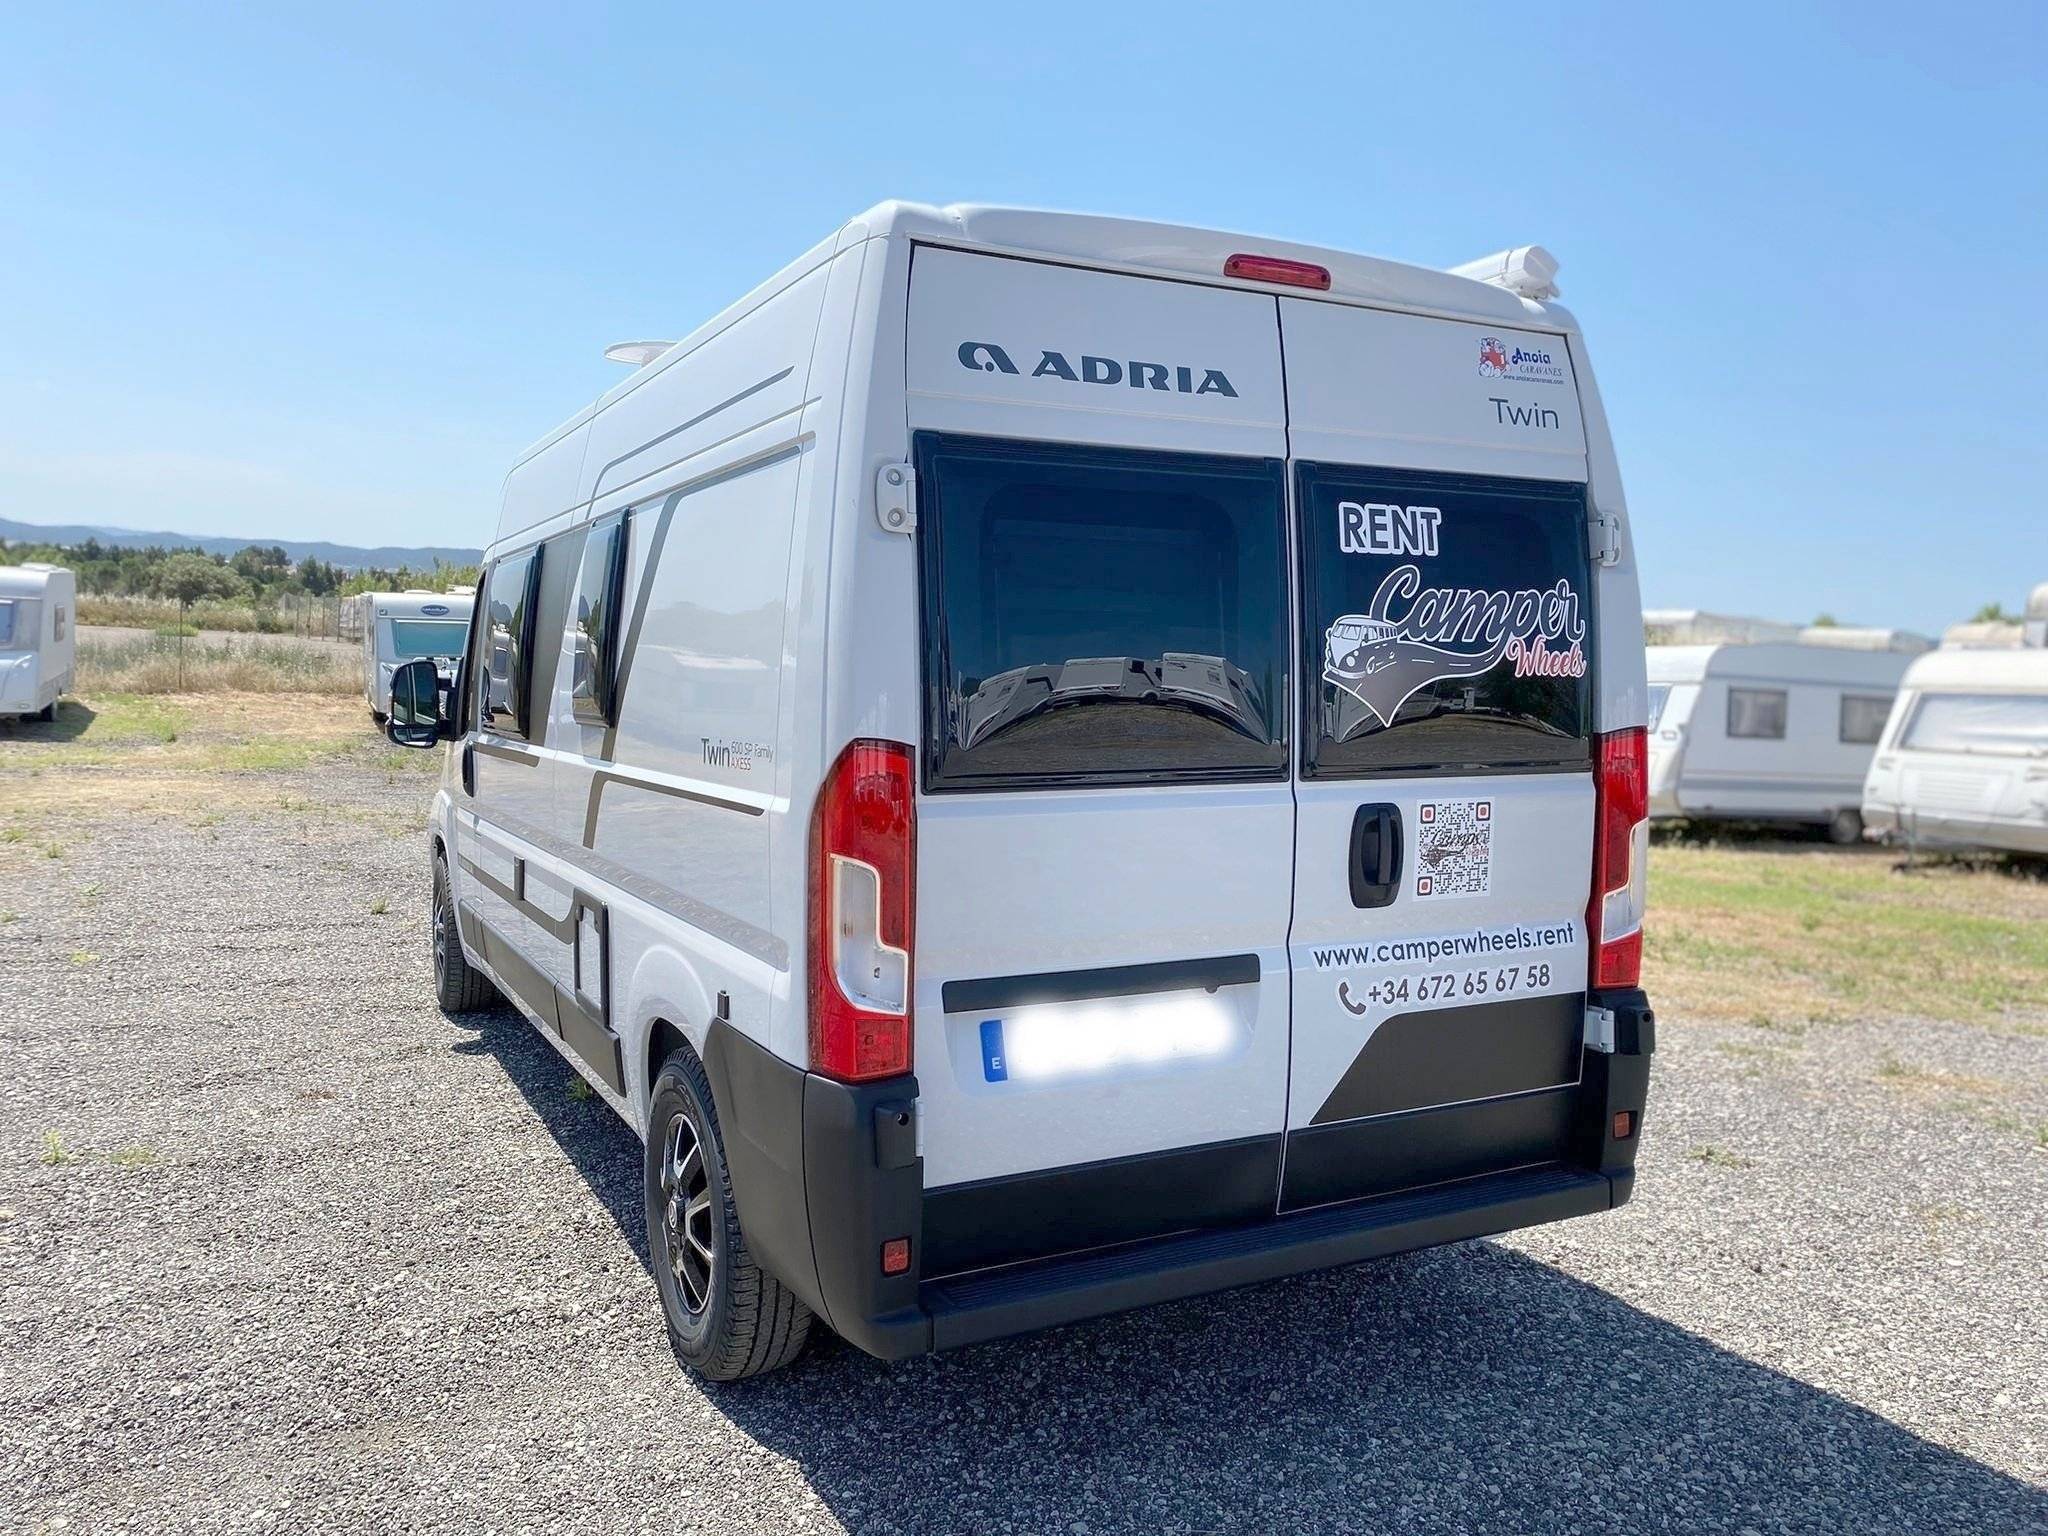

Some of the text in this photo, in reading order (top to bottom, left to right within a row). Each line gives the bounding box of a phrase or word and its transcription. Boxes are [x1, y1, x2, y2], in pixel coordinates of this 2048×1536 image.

[1031, 350, 1240, 398] ADRIA
[1511, 347, 1551, 365] Anoia
[1519, 364, 1563, 377] CARAVANES
[1489, 396, 1560, 430] Twin
[1339, 502, 1442, 556] RENT
[1369, 564, 1586, 650] Camper
[1506, 634, 1587, 678] Wheels
[701, 738, 730, 768] Twin
[1313, 922, 1575, 968] www.camperwheels.rent
[1368, 963, 1551, 1005] +34 672 65 67 58
[991, 1057, 1001, 1070] E
